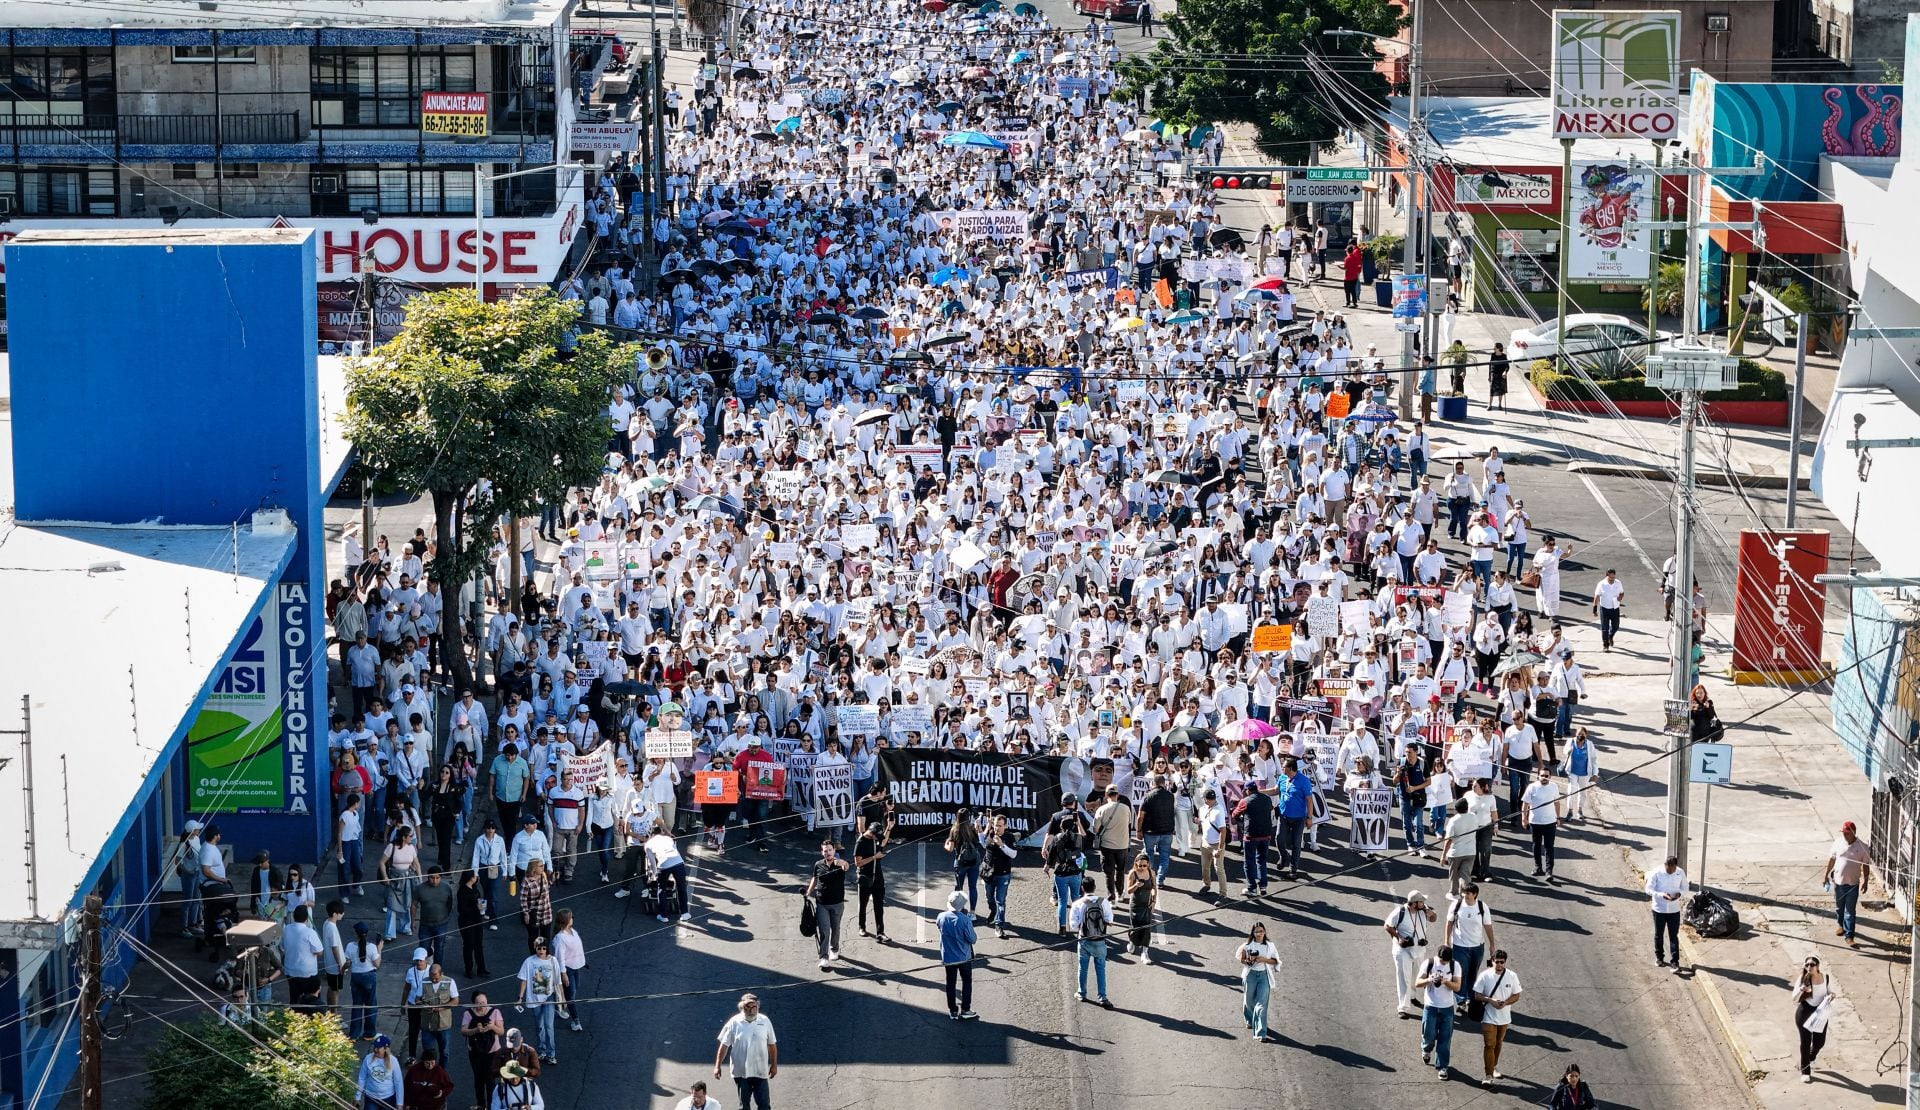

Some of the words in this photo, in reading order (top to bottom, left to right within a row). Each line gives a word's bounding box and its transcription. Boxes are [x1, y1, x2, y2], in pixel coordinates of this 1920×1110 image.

[426, 95, 466, 110] ANUNCIATE
[467, 96, 485, 111] AQUI
[1556, 93, 1676, 108] Librerías
[425, 115, 484, 134] 66-71-55-51-86
[1556, 112, 1675, 133] MEXICO
[1309, 170, 1324, 178] CALLE
[1327, 170, 1340, 178] JUAN
[1342, 170, 1354, 178] JOSE
[1355, 170, 1368, 178] RIOS
[1288, 187, 1295, 196] P.
[1296, 186, 1307, 196] DE
[1308, 185, 1349, 196] GOBIERNO
[1496, 188, 1550, 198] MEXICO
[958, 216, 992, 226] JUSTICIA
[994, 216, 1017, 225] PARA
[958, 226, 994, 235] RARDO
[995, 225, 1025, 235] MIZAEL
[323, 228, 538, 274] HOUSE
[1111, 544, 1131, 555] JUS
[280, 585, 308, 603] LA
[1323, 680, 1353, 689] AYUDA
[284, 606, 308, 811] COLCHONERA
[775, 741, 792, 751] CON
[792, 757, 809, 766] CON
[574, 775, 585, 784] NO
[816, 769, 833, 779] CON
[834, 767, 850, 777] LOS
[911, 761, 935, 779] ¡EN
[939, 761, 1002, 785] MEMORIA
[1008, 766, 1025, 785] DE
[816, 778, 850, 791] NIÑOS
[889, 780, 964, 804] RICARDO
[969, 783, 1037, 809] MIZAEL!
[1356, 793, 1372, 803] CON
[1374, 793, 1389, 803] LOS
[817, 792, 852, 821] NO
[1355, 802, 1388, 816] NIÑOS
[898, 812, 943, 826] EXIGIMOS
[945, 813, 957, 826] PA
[1354, 817, 1386, 846] NO
